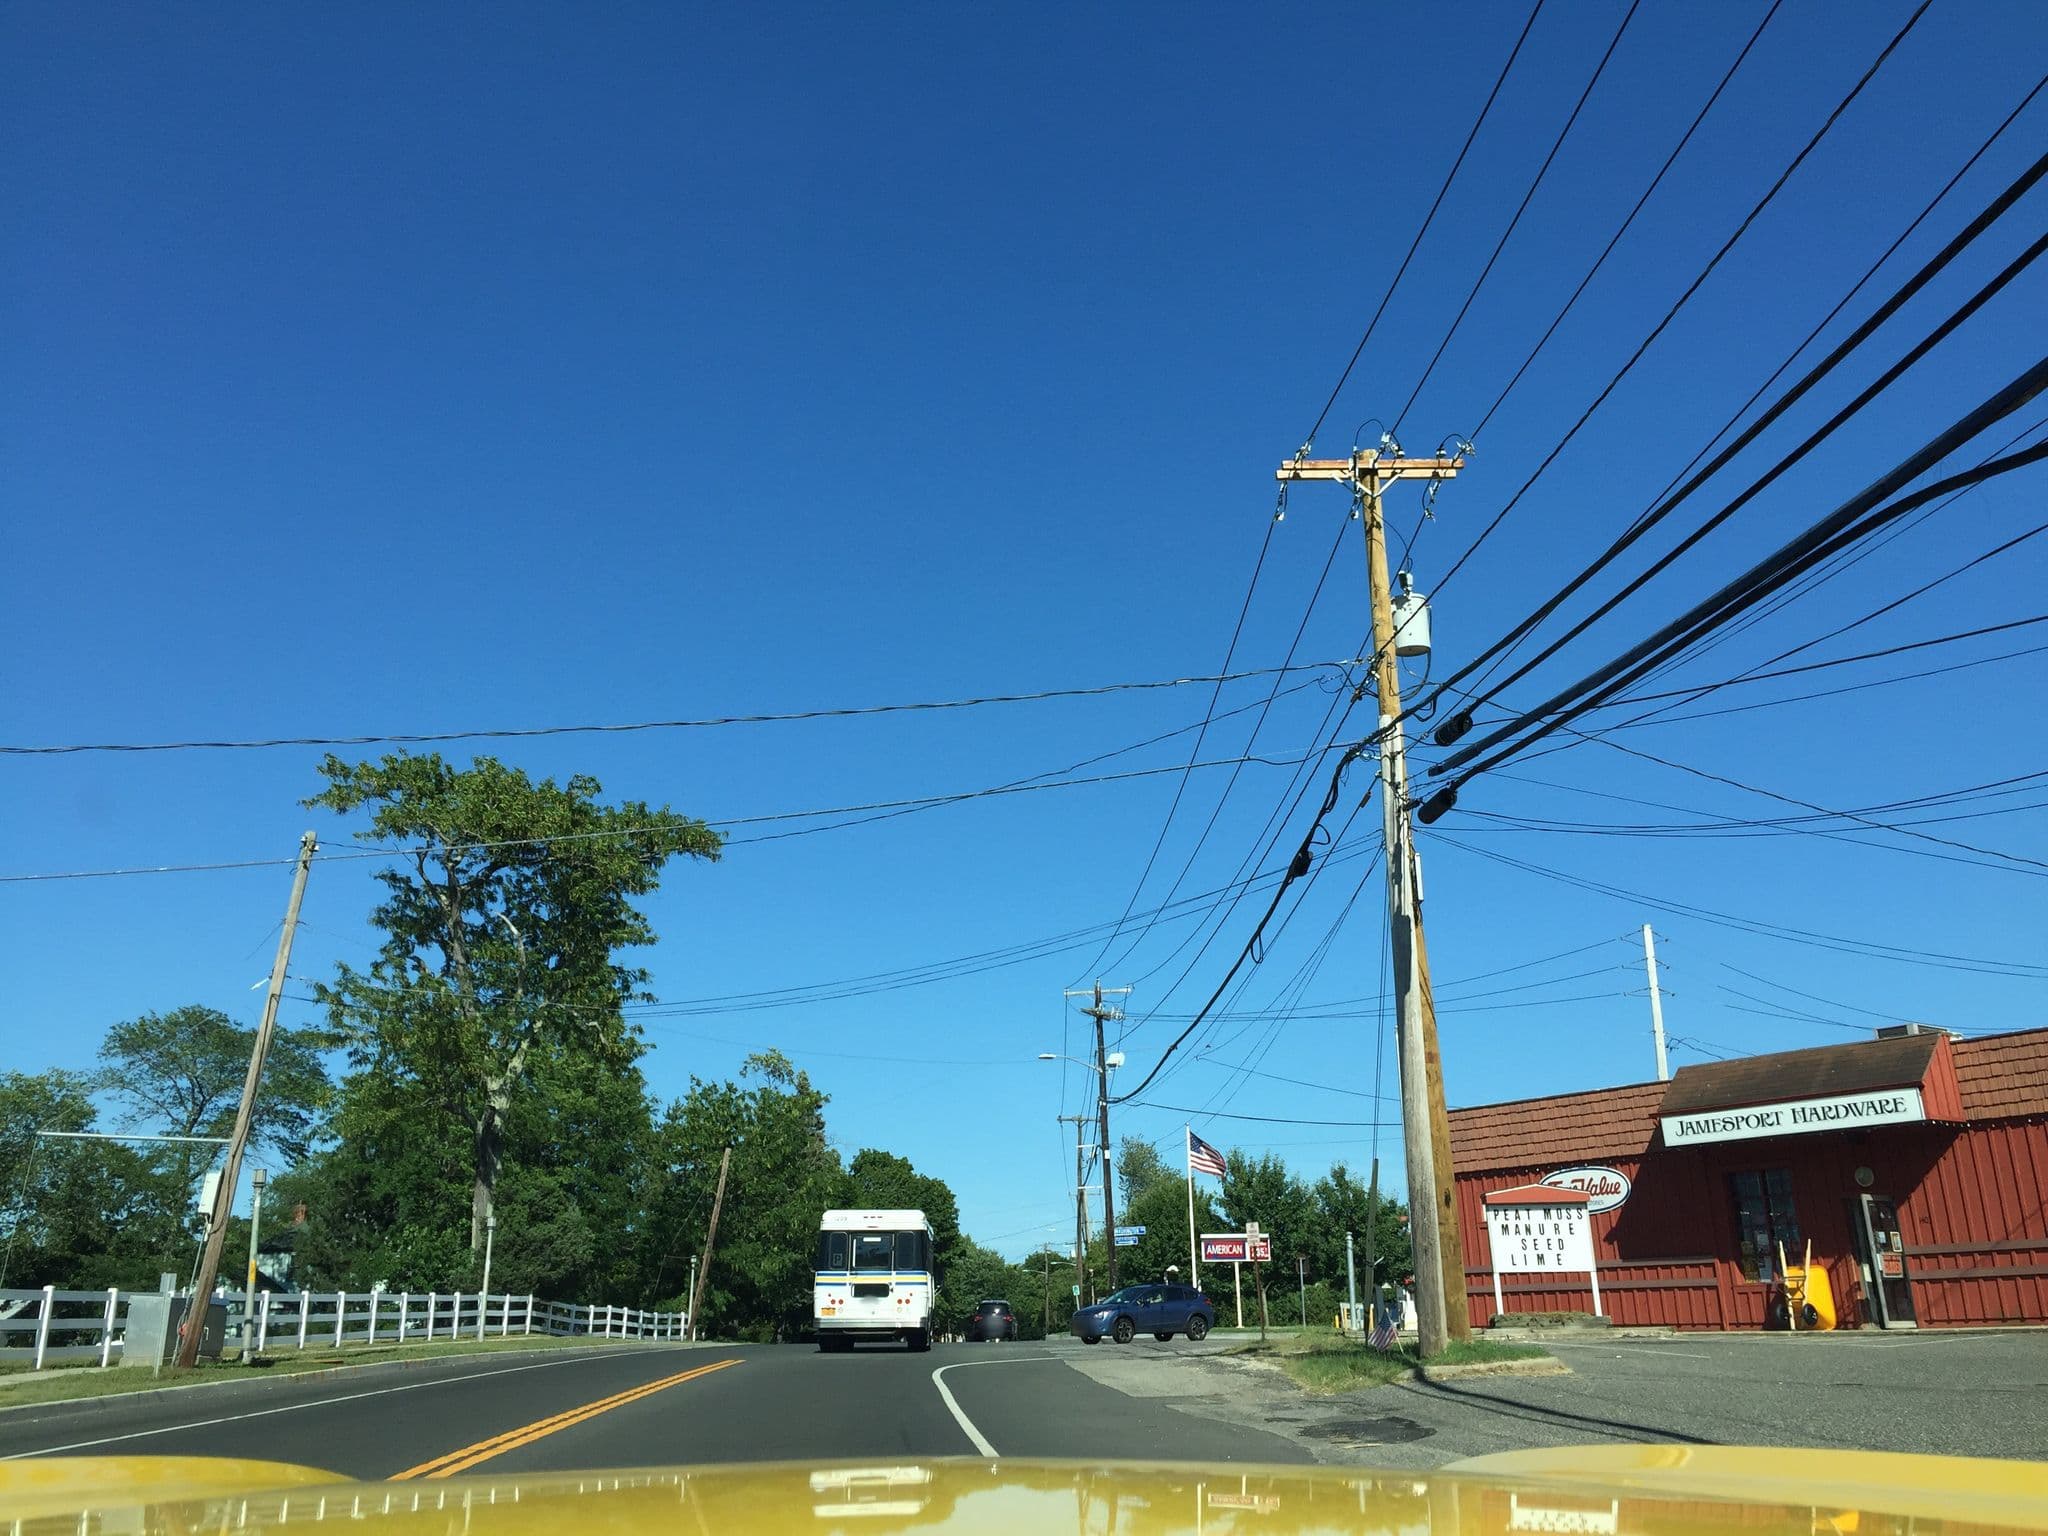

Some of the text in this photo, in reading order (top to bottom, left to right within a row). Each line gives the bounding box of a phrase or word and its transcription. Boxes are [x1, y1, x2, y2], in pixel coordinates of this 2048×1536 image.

[1675, 1097, 1907, 1137] JAMESPORT HARDWARE
[1571, 1176, 1621, 1196] Value
[1494, 1207, 1583, 1221] PEAT MOSS
[1501, 1222, 1575, 1236] MANURE
[1206, 1244, 1243, 1255] AMERICAN
[1521, 1238, 1564, 1251] SEED
[1511, 1253, 1563, 1266] LIME
